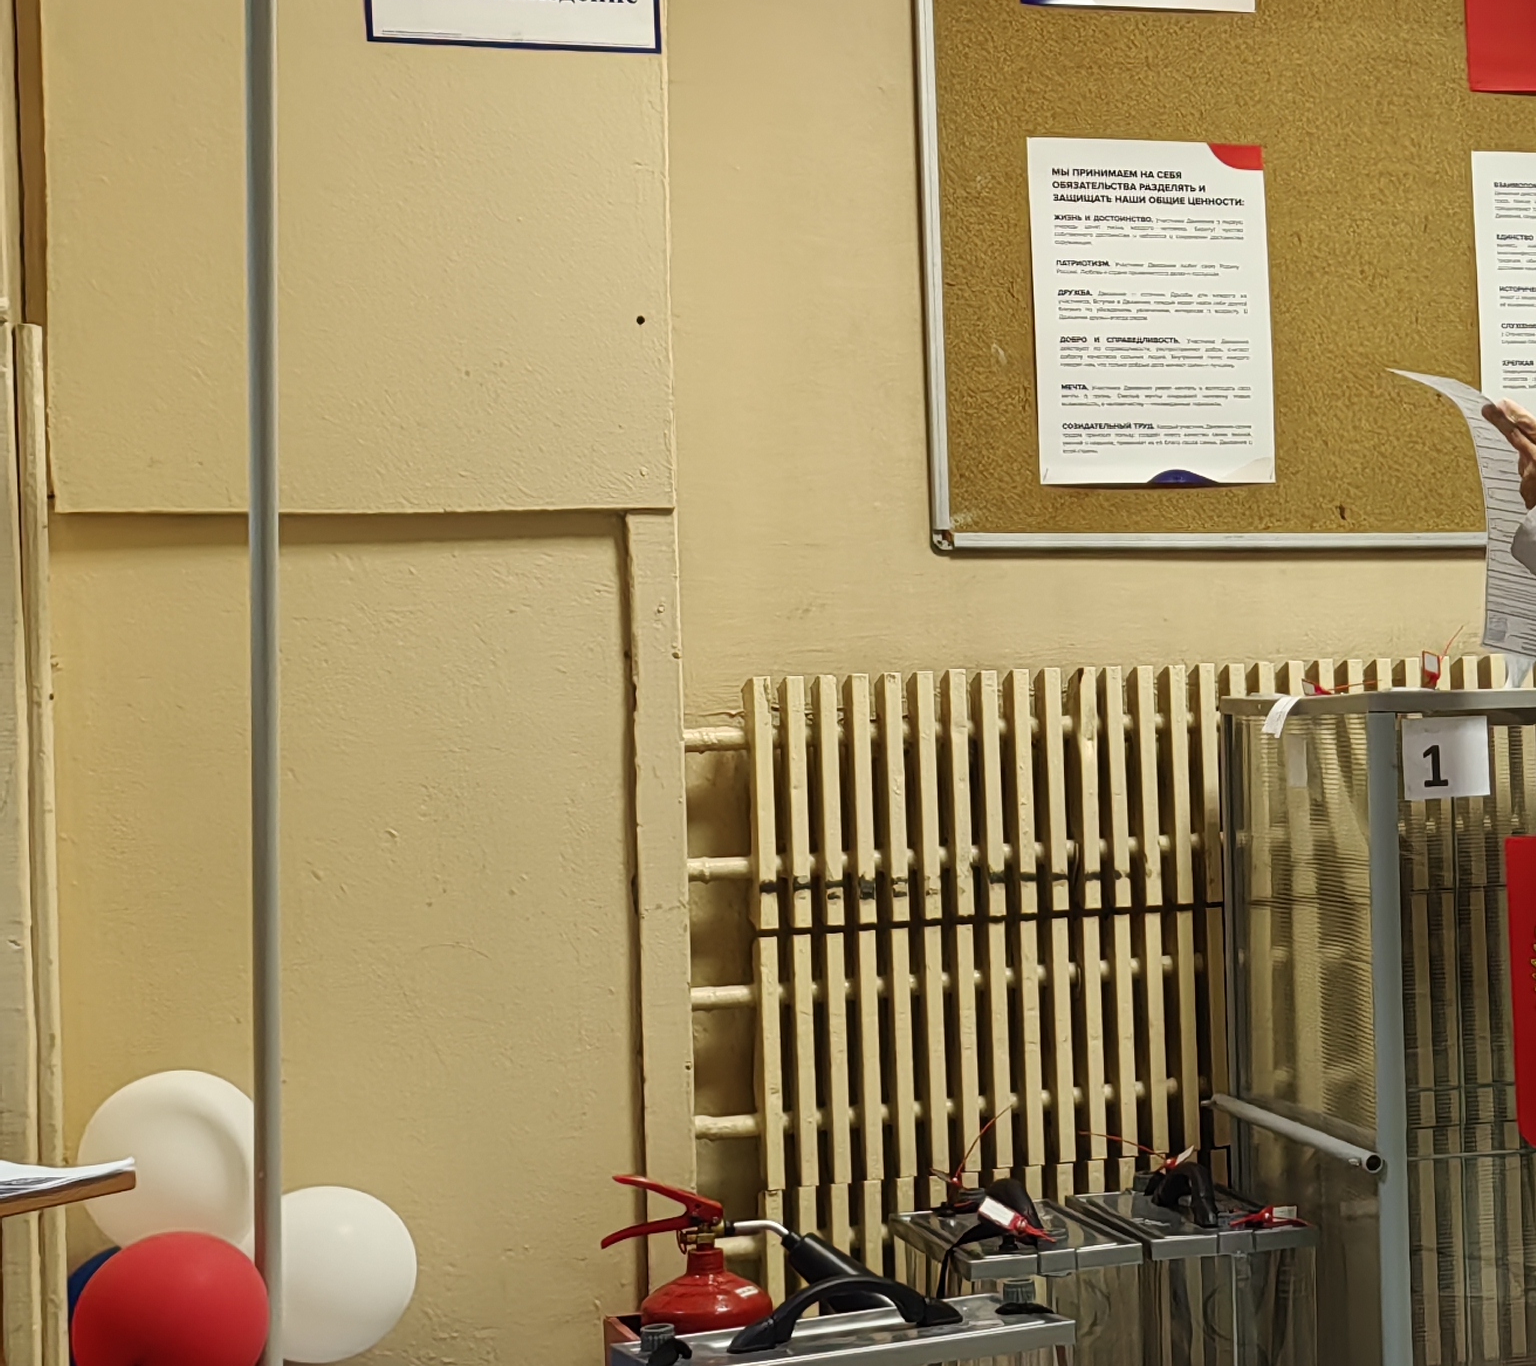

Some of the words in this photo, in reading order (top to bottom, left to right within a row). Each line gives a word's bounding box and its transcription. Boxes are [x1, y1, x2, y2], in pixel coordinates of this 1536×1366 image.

[1052, 168, 1069, 177] МЫ
[1072, 169, 1138, 178] ПРИНИМАЕМ
[1157, 171, 1181, 179] СЕБЯ
[1052, 181, 1136, 191] ОБЯЗАТЕЛЬСТВА
[1139, 184, 1196, 192] РАЗДЕЛЯТЬ
[1053, 194, 1111, 203] ЗАЩИЩАТЬ
[1115, 196, 1146, 204] НАШИ
[1149, 197, 1185, 205] ОБЩИЕ
[1188, 197, 1244, 207] ЦЕННОСТИ:
[1423, 745, 1449, 787] 1
